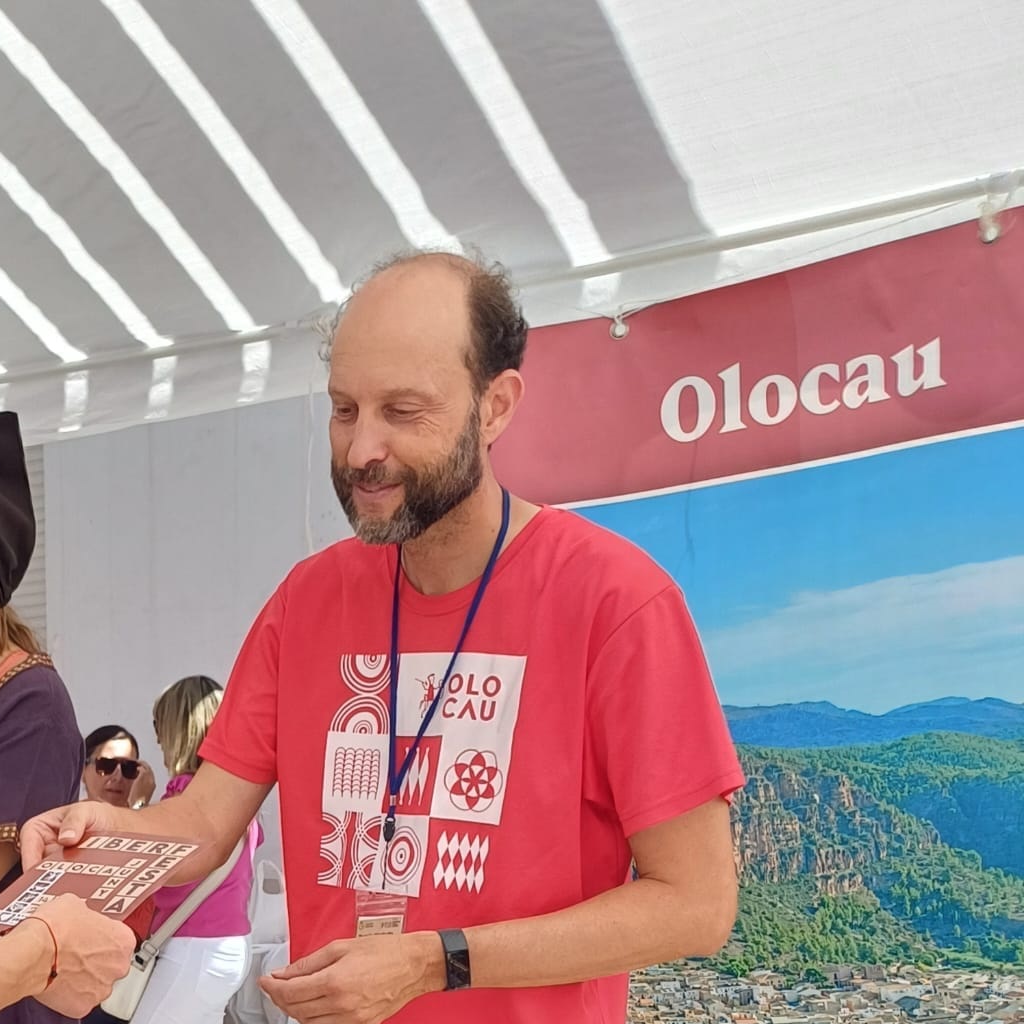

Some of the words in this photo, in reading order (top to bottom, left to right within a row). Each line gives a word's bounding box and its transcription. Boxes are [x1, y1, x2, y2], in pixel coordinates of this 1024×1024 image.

[660, 337, 948, 443] Olocau
[448, 673, 502, 698] OLO
[442, 697, 497, 721] CAU
